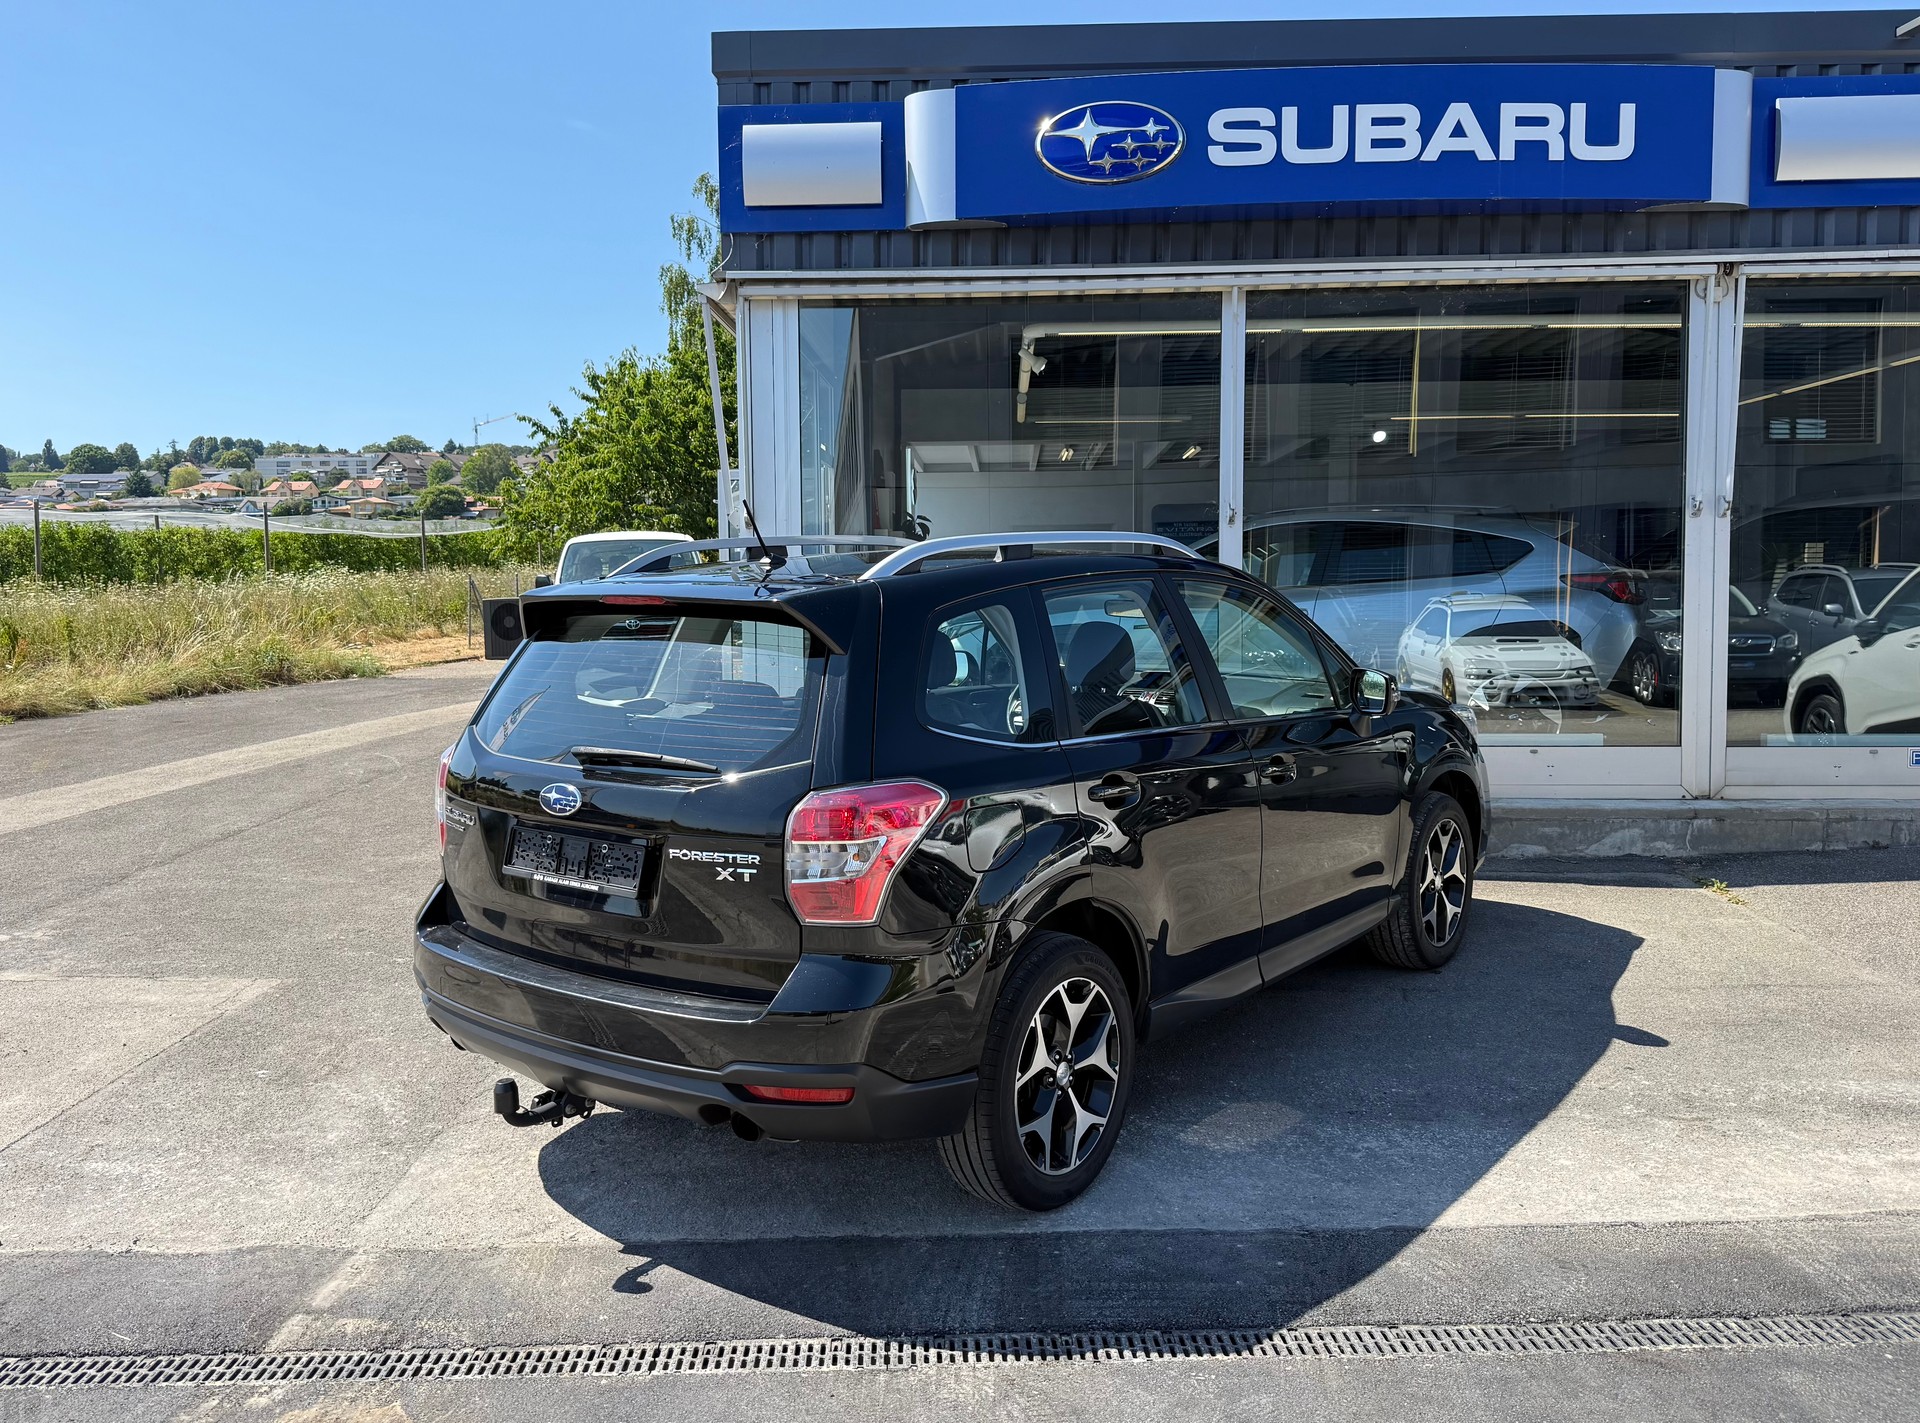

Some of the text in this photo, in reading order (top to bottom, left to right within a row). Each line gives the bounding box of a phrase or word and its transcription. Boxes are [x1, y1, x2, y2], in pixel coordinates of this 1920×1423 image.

[1207, 102, 1637, 167] SUBARU
[668, 848, 761, 865] FORESTER
[715, 866, 758, 882] XT
